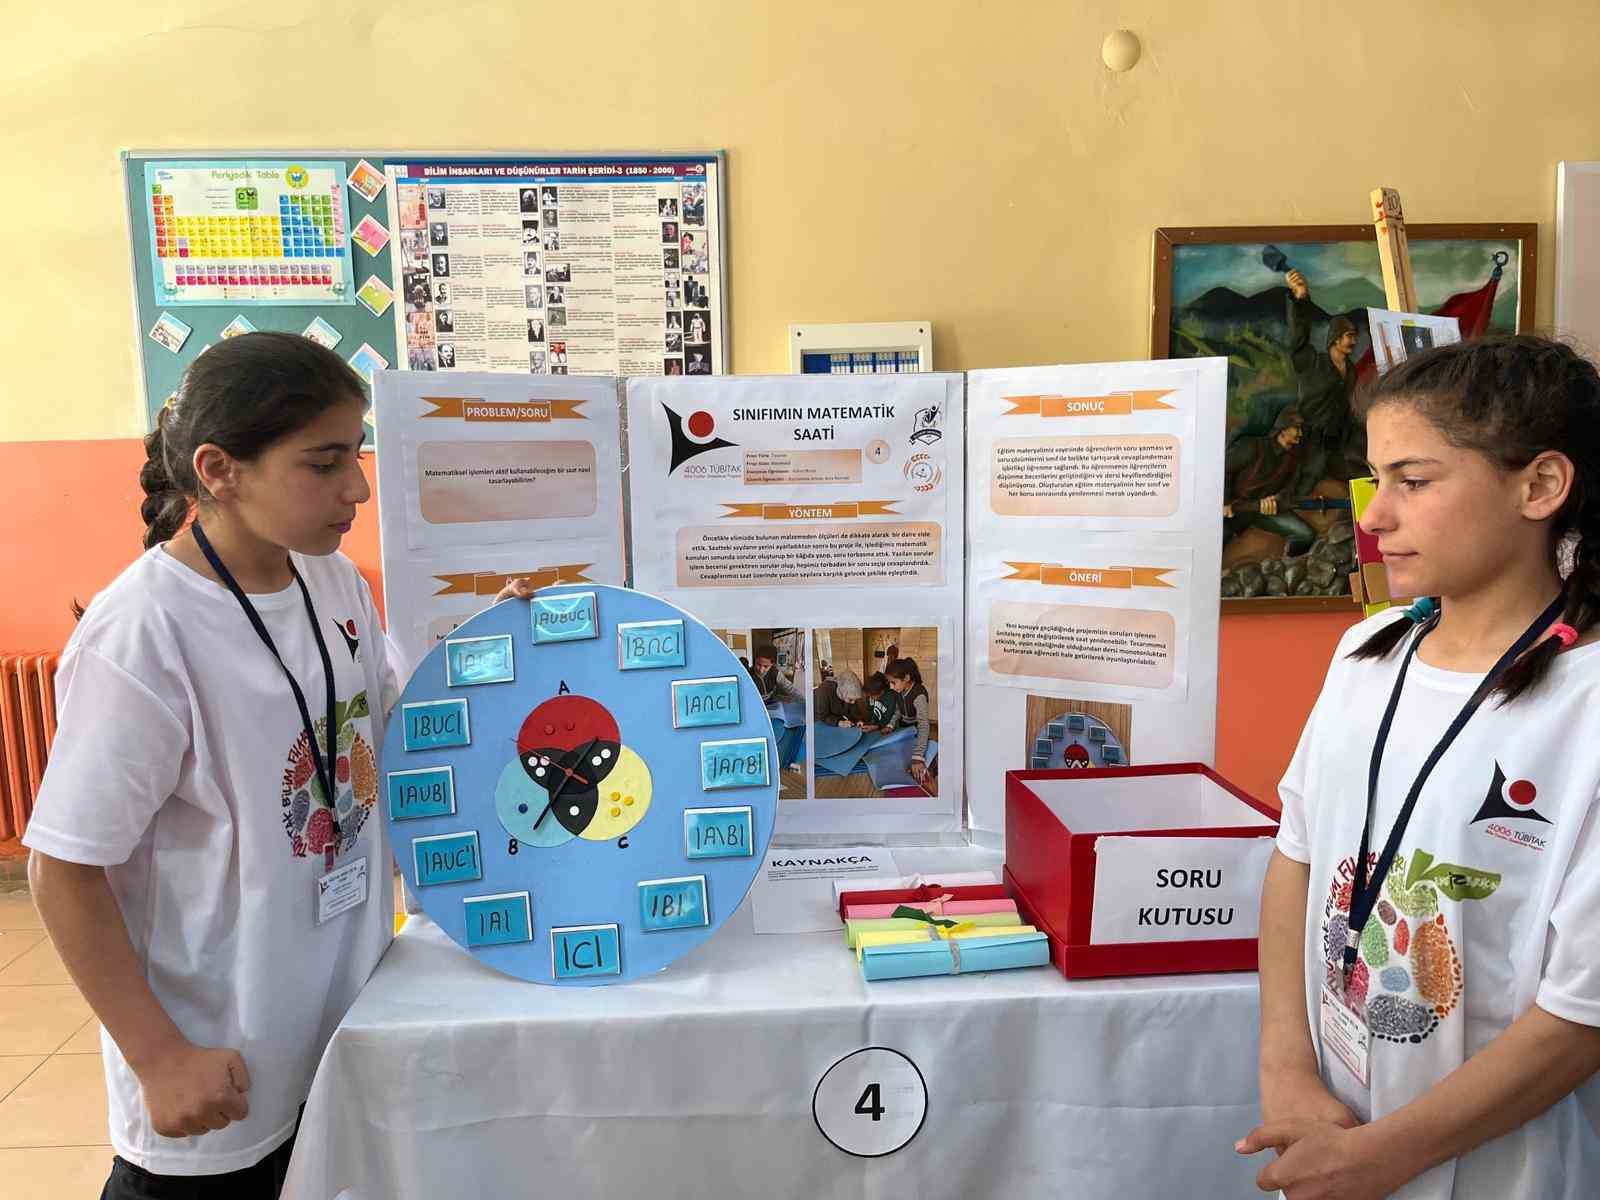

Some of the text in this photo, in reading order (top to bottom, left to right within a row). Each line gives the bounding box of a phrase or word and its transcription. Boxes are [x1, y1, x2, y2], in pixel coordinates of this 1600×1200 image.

[467, 406, 549, 419] PROBLEM/SORU
[733, 405, 896, 421] SINIFIMIN MATEMATİK
[1066, 400, 1105, 413] SONUÇ
[793, 425, 834, 441] SAATİ
[684, 464, 707, 473] 4006
[788, 505, 833, 518] YÖNTEM
[1069, 571, 1102, 583] ÖNERİ
[558, 680, 570, 695] A
[508, 838, 519, 855] B
[617, 836, 629, 849] C
[771, 855, 872, 868] KAYNAKÇA
[1156, 869, 1222, 888] SORU
[1138, 908, 1234, 926] KUTUSU
[854, 1083, 885, 1121] 4
